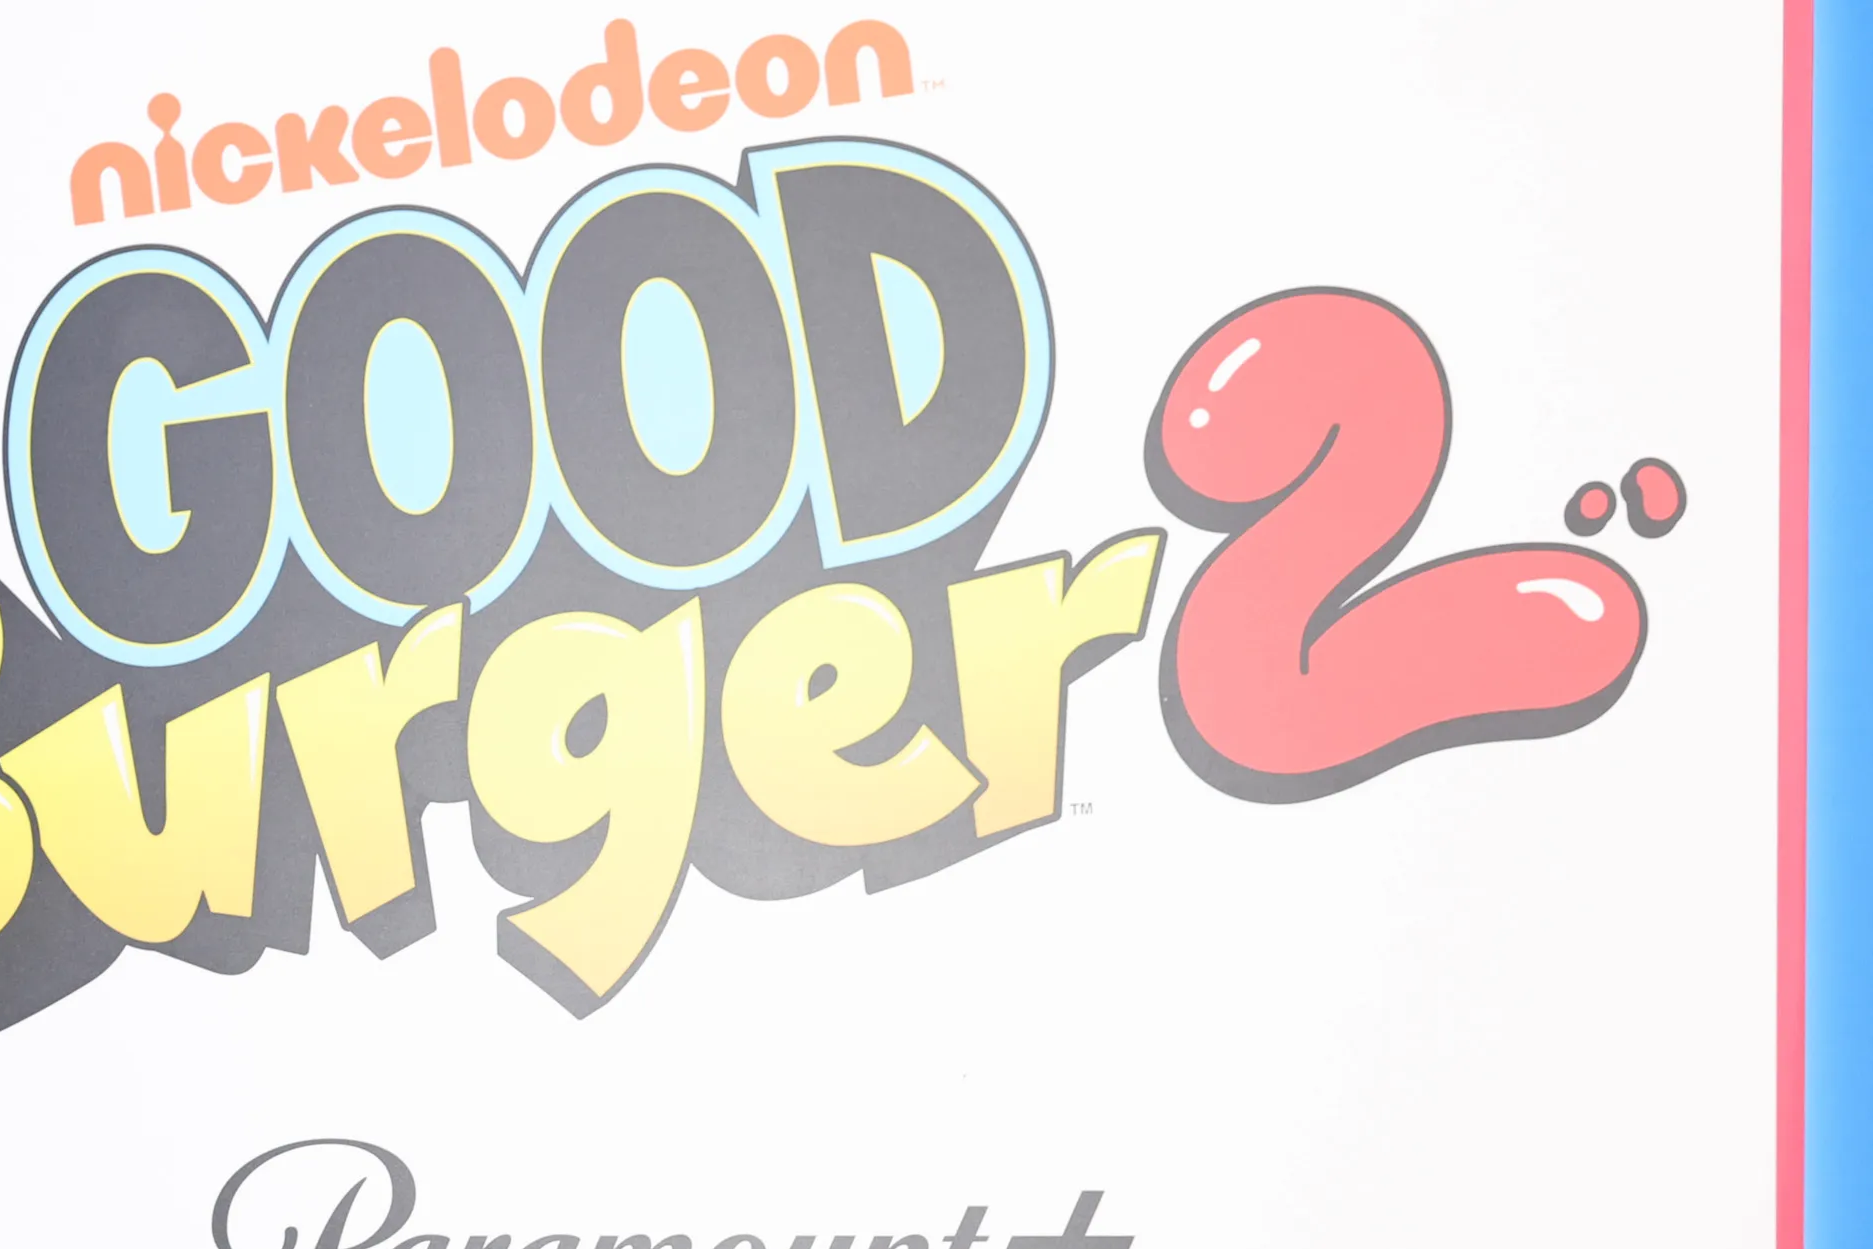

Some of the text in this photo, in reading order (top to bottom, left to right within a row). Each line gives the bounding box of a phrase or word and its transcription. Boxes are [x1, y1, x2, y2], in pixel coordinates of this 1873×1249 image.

[70, 17, 914, 226] nickelodeon
[6, 138, 1053, 667] GOOD
[1144, 286, 1648, 804] 2
[1069, 802, 1093, 817] TM
